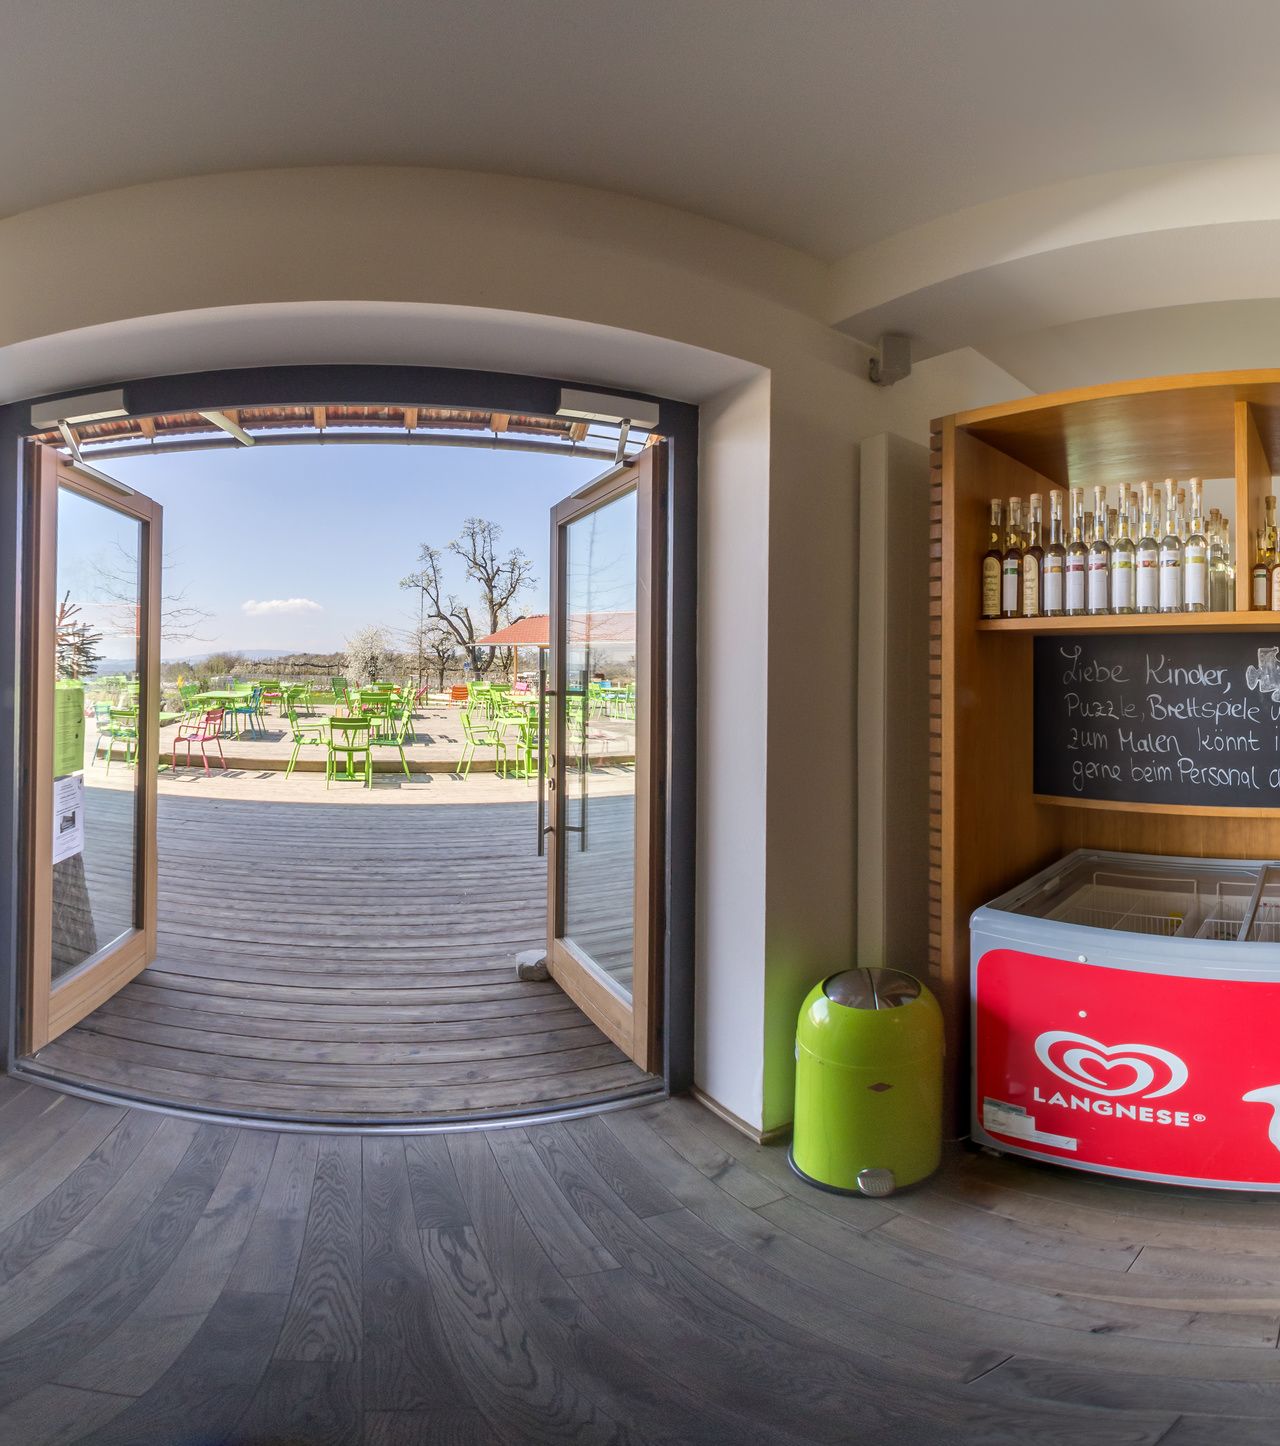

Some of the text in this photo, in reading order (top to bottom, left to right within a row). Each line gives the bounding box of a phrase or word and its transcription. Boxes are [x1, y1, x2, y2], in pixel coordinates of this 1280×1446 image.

[1060, 645, 1231, 694] Liebe Kinder,
[1064, 692, 1145, 723] Puzzle,
[1146, 693, 1261, 725] Brettspiele
[1066, 727, 1108, 750] zum
[1118, 728, 1182, 756] Malen
[1197, 726, 1261, 752] könnt
[1072, 760, 1123, 792] gerne
[1130, 758, 1172, 783] beim
[1177, 757, 1260, 790] Personal
